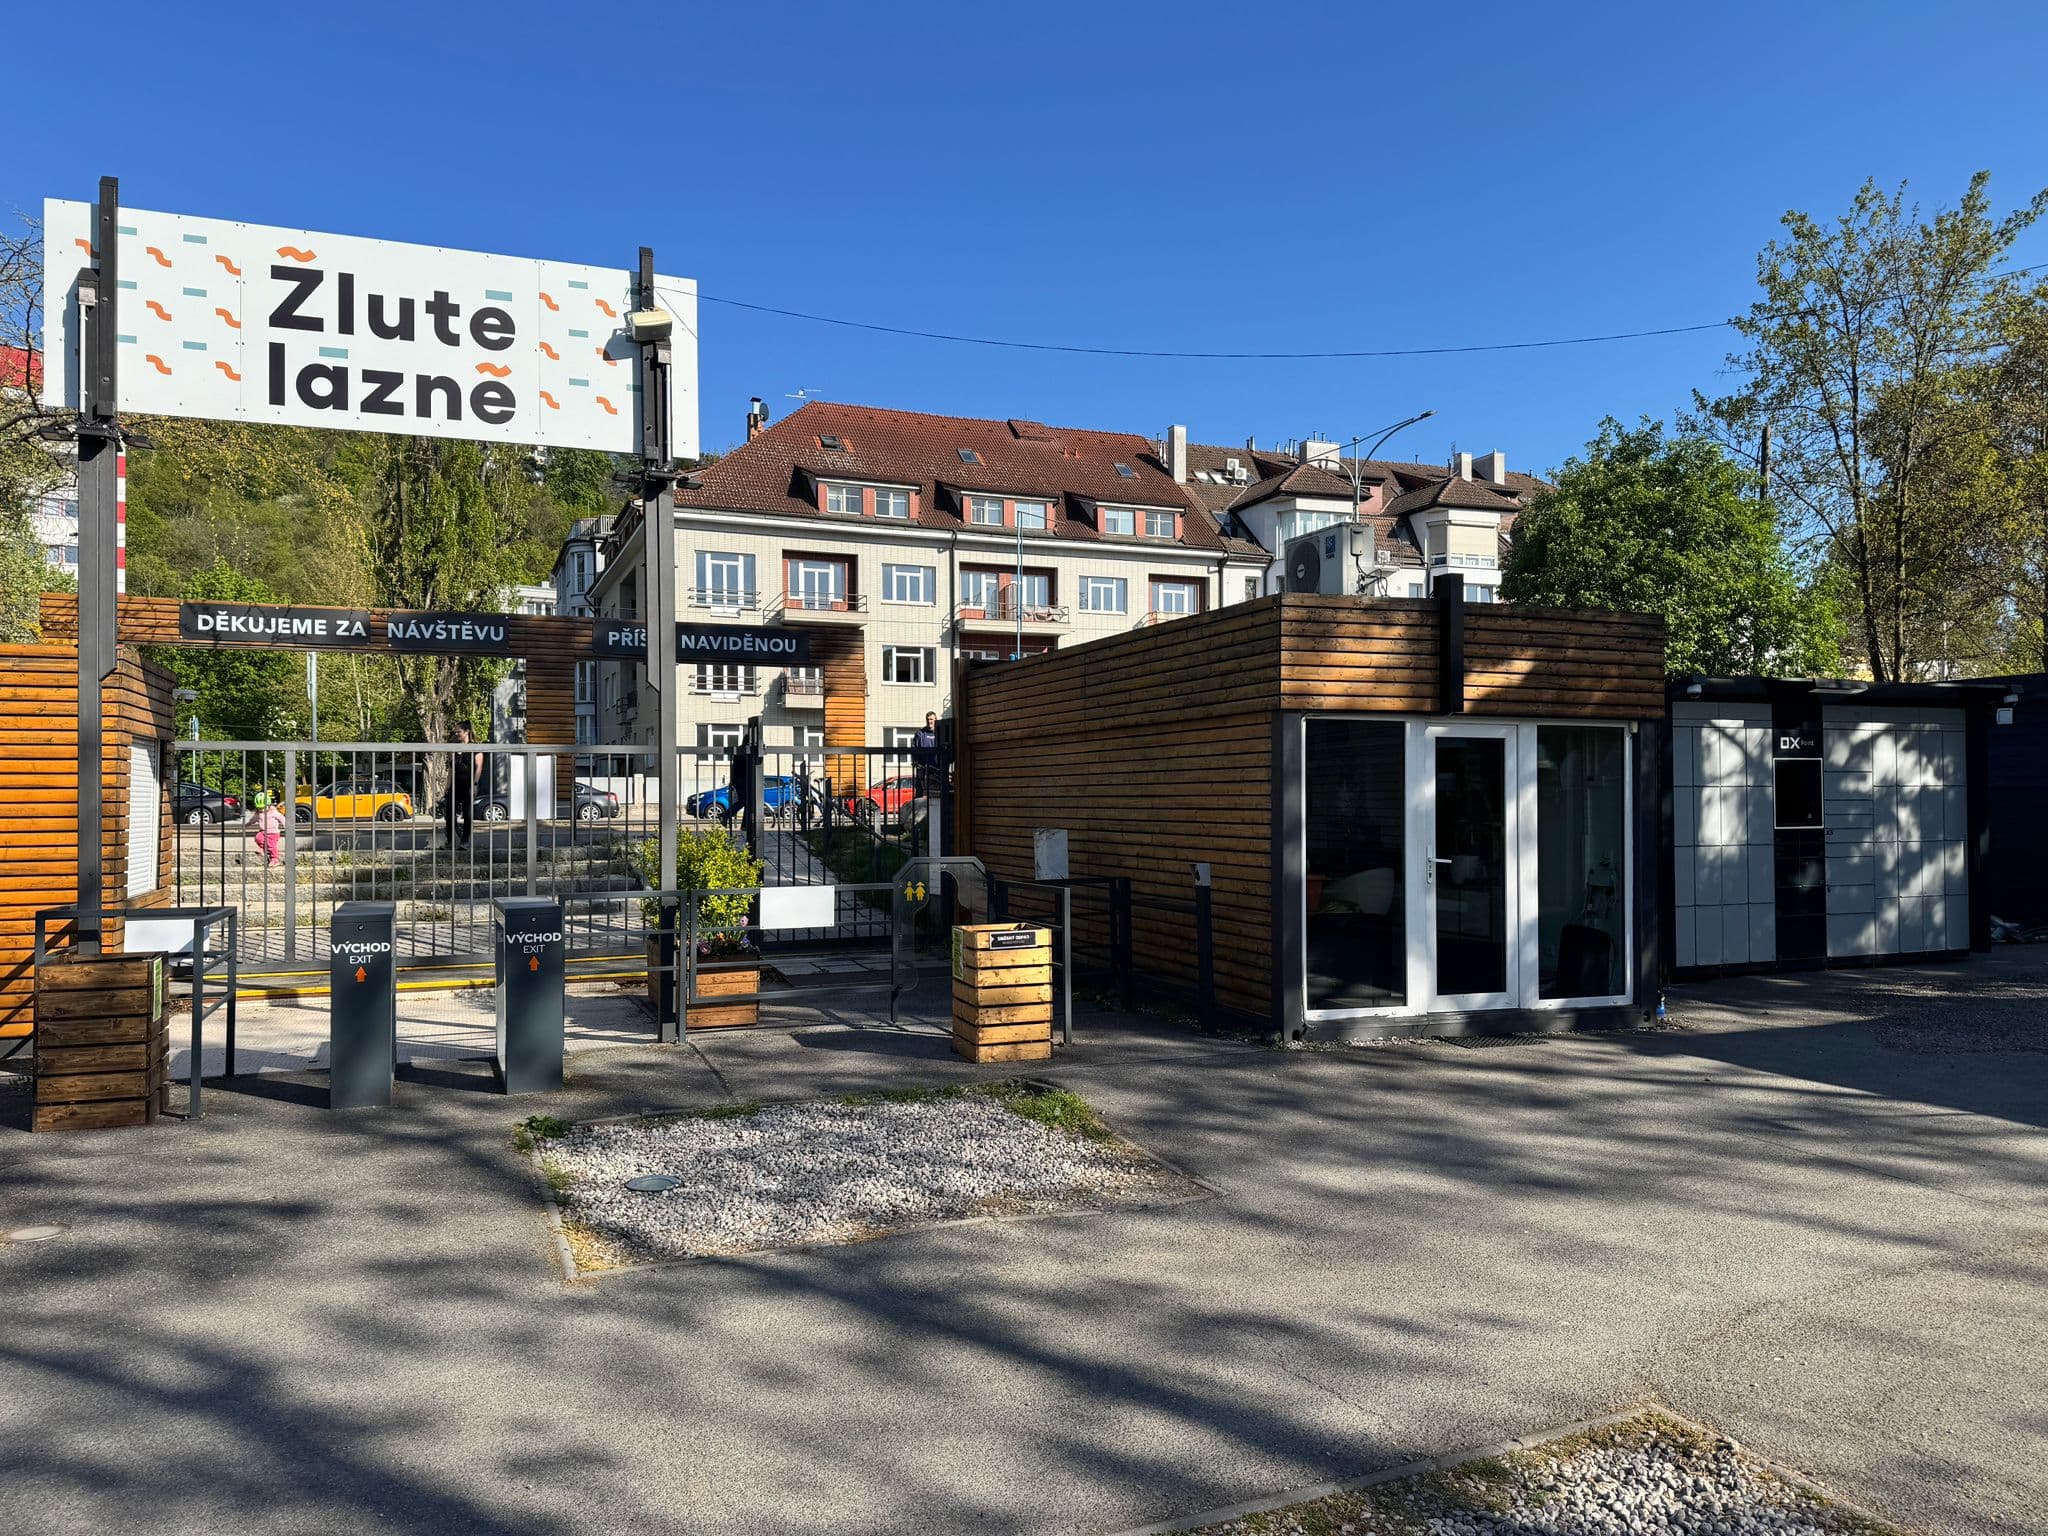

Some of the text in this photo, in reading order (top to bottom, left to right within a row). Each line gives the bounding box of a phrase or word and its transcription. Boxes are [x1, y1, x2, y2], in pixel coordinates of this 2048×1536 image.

[197, 611, 505, 642] DĚKUJEME ZA NÁVŠTĚVU
[608, 627, 796, 653] PŘÍŠ NAVIDĚNOU
[505, 931, 562, 944] VÝCHOD
[332, 941, 391, 954] VÝCHOD
[523, 945, 545, 954] EXIT
[349, 954, 374, 965] EXIT
